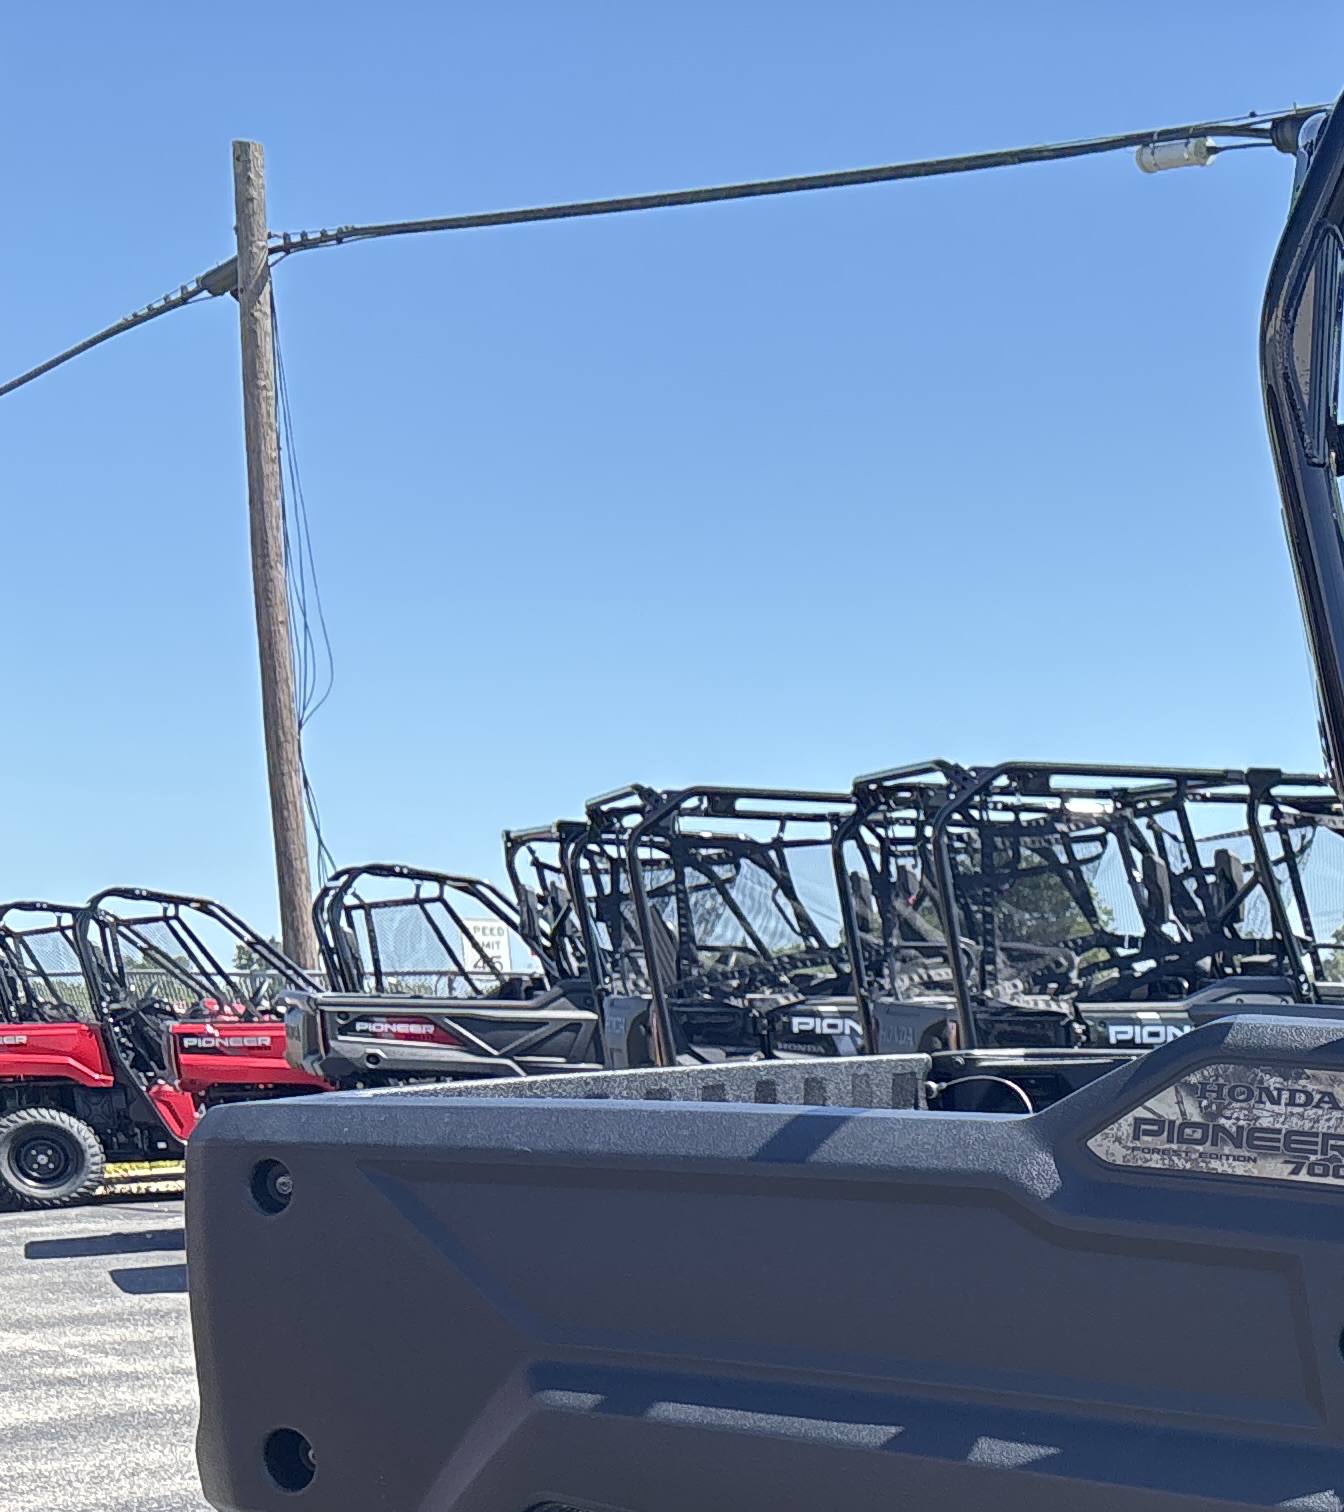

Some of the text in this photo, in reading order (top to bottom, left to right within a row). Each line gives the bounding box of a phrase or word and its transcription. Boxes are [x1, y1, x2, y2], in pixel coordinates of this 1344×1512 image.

[473, 925, 505, 937] PEED
[481, 940, 501, 950] MIT
[355, 1020, 435, 1035] PIONEER
[182, 1035, 272, 1049] PIONEER
[1196, 1080, 1343, 1111] HONDA
[1130, 1145, 1258, 1164] FOREST EDITION
